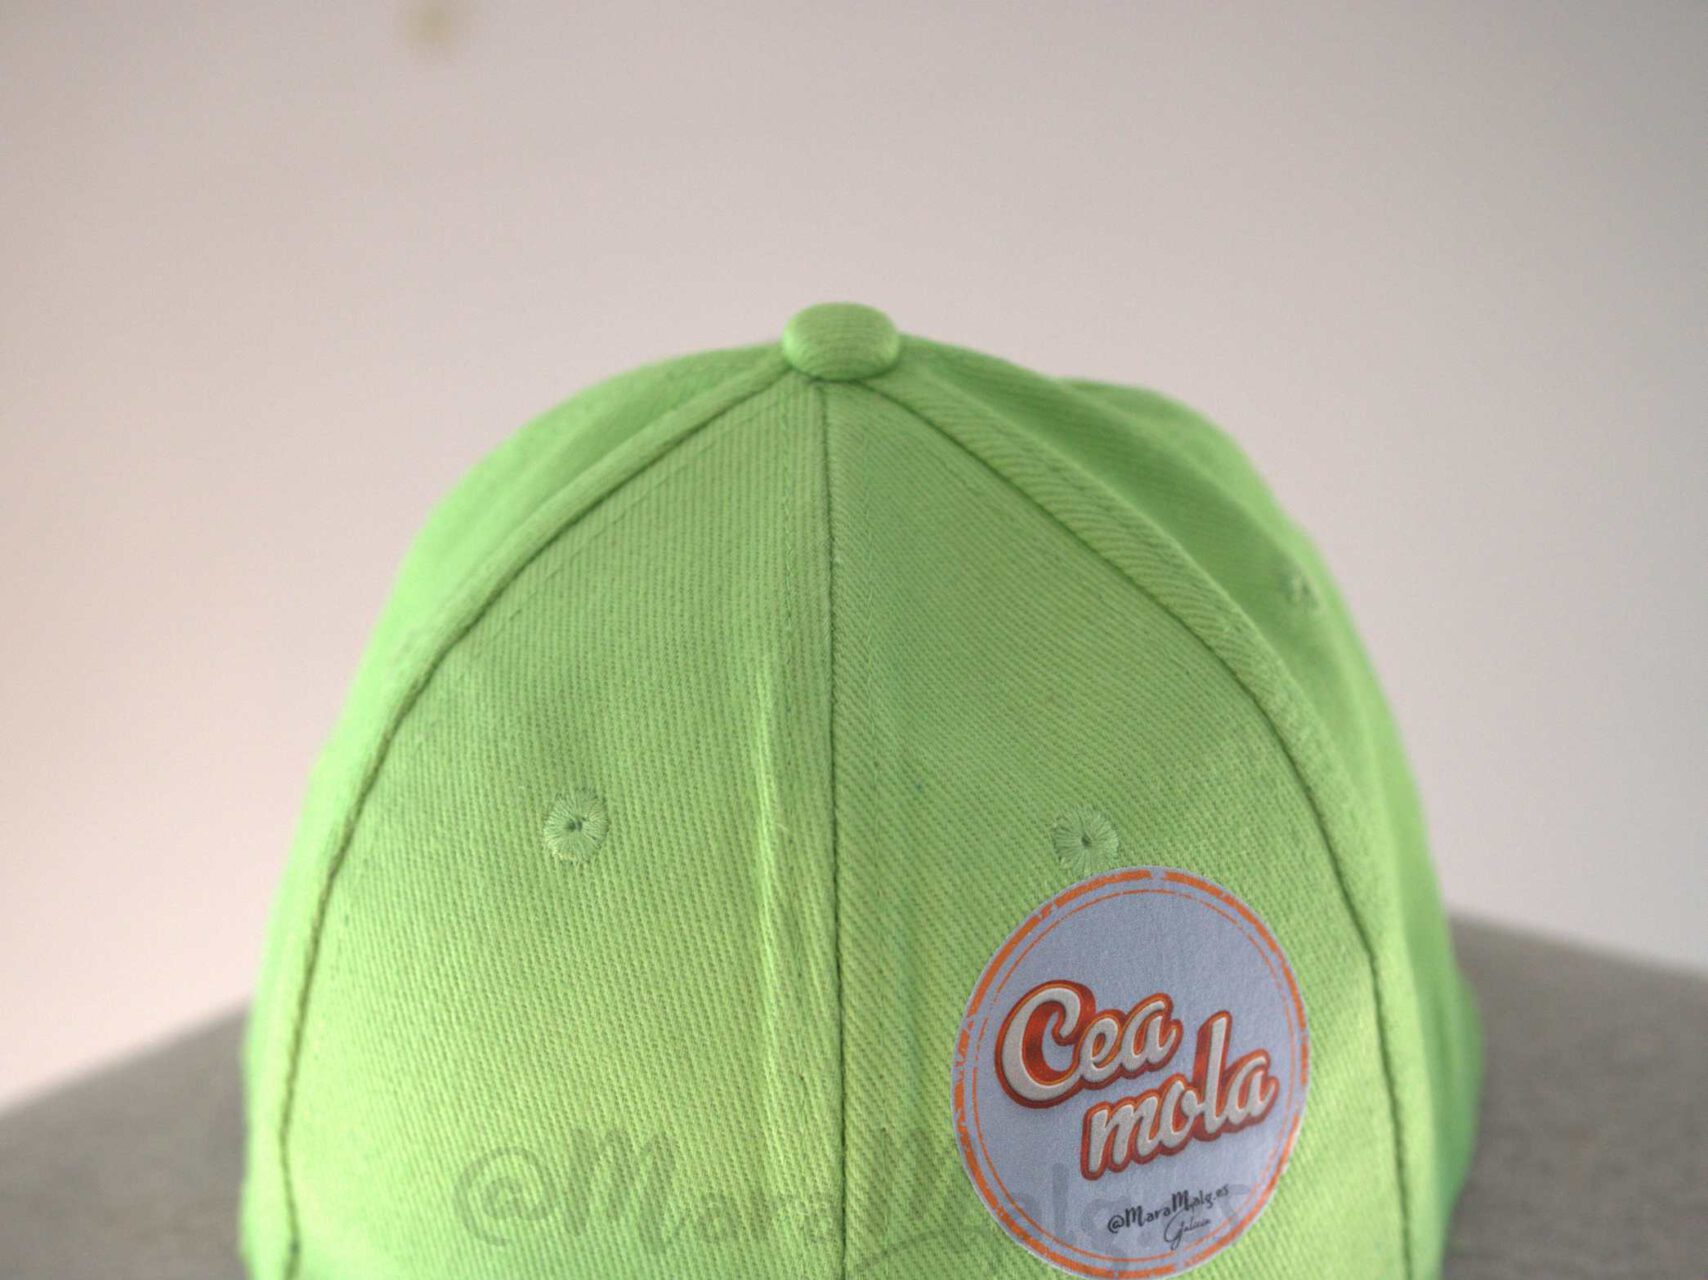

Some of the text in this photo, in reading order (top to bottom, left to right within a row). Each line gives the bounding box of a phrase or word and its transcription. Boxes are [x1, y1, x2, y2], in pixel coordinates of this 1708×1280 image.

[995, 979, 1183, 1109] Cea
[1079, 1010, 1280, 1181] mola
[1107, 1183, 1229, 1234] @MaraMalg.es
[1163, 1207, 1212, 1250] Galicia
